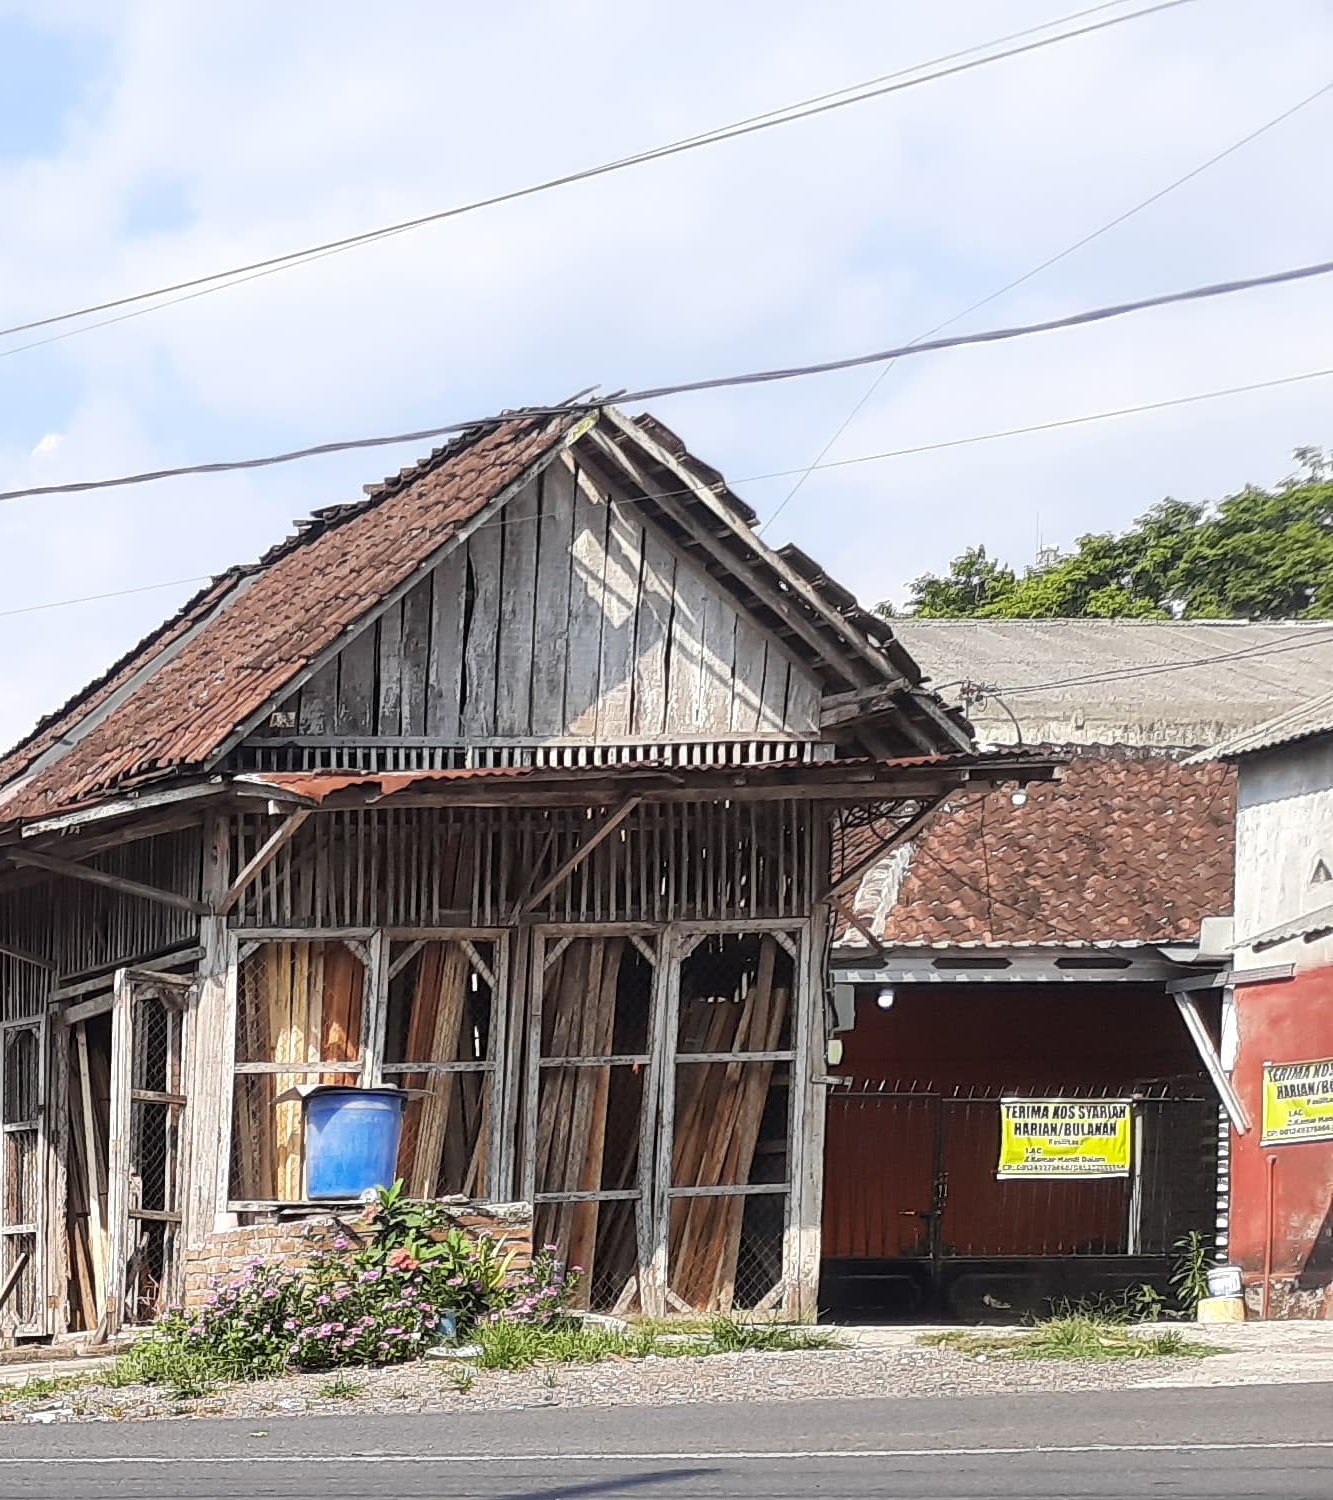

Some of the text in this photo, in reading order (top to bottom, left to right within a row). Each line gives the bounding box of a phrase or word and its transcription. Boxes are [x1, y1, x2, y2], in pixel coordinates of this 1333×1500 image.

[1268, 1066, 1310, 1082] TERIMA
[1005, 1105, 1126, 1119] TERIMA KOS SYARIAH
[1013, 1122, 1117, 1136] HARIAN/BULANAN
